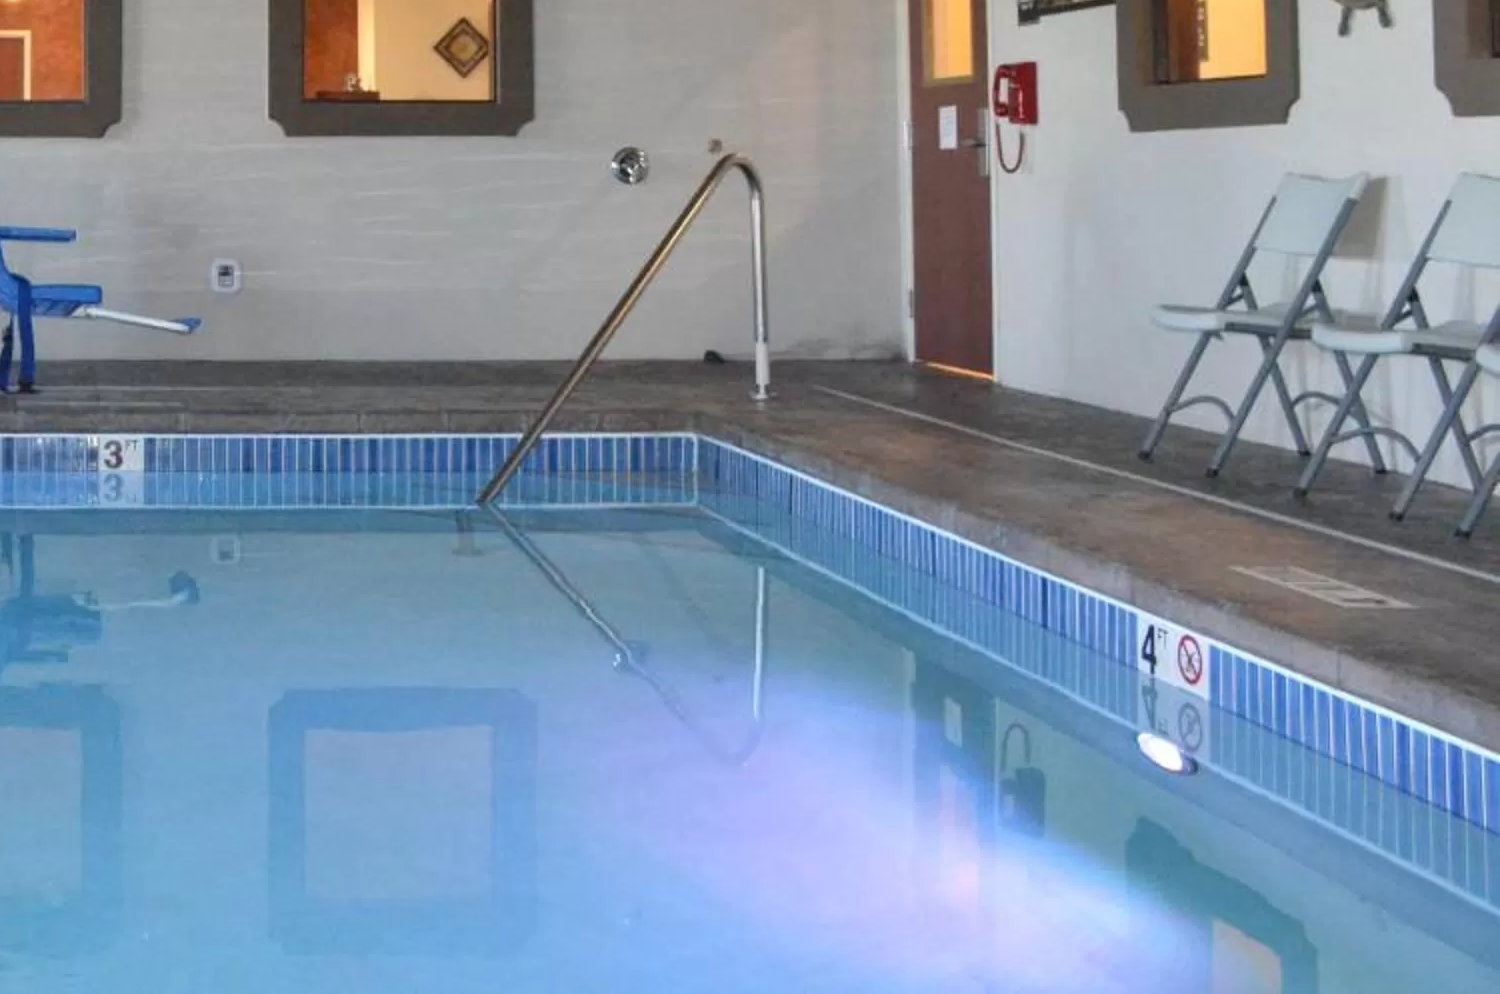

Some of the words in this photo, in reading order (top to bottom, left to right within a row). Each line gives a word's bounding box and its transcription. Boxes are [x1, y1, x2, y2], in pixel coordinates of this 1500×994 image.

[103, 439, 124, 470] 3
[1141, 624, 1157, 676] 4
[1157, 626, 1170, 651] FT
